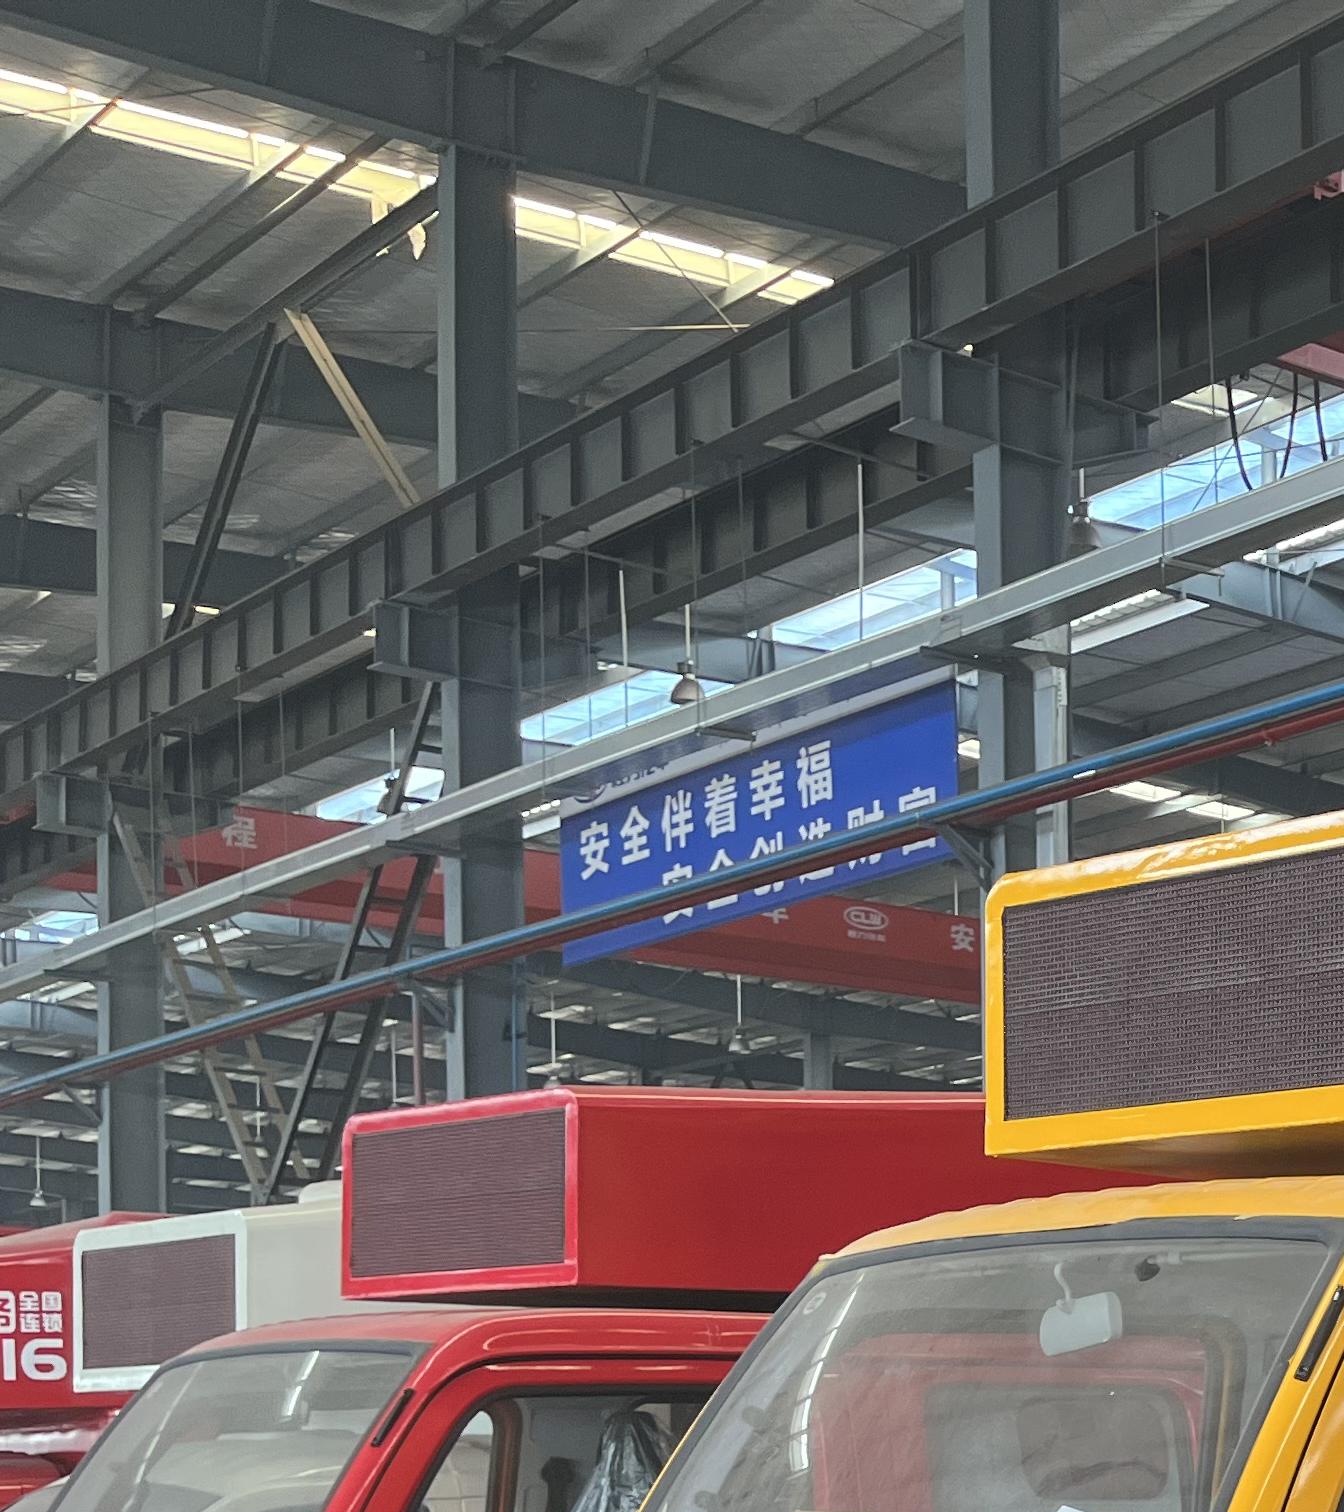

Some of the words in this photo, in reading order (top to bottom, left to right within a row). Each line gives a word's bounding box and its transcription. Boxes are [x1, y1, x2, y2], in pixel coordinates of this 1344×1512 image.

[579, 740, 834, 881] 安全伴着幸福
[951, 923, 975, 952] 安
